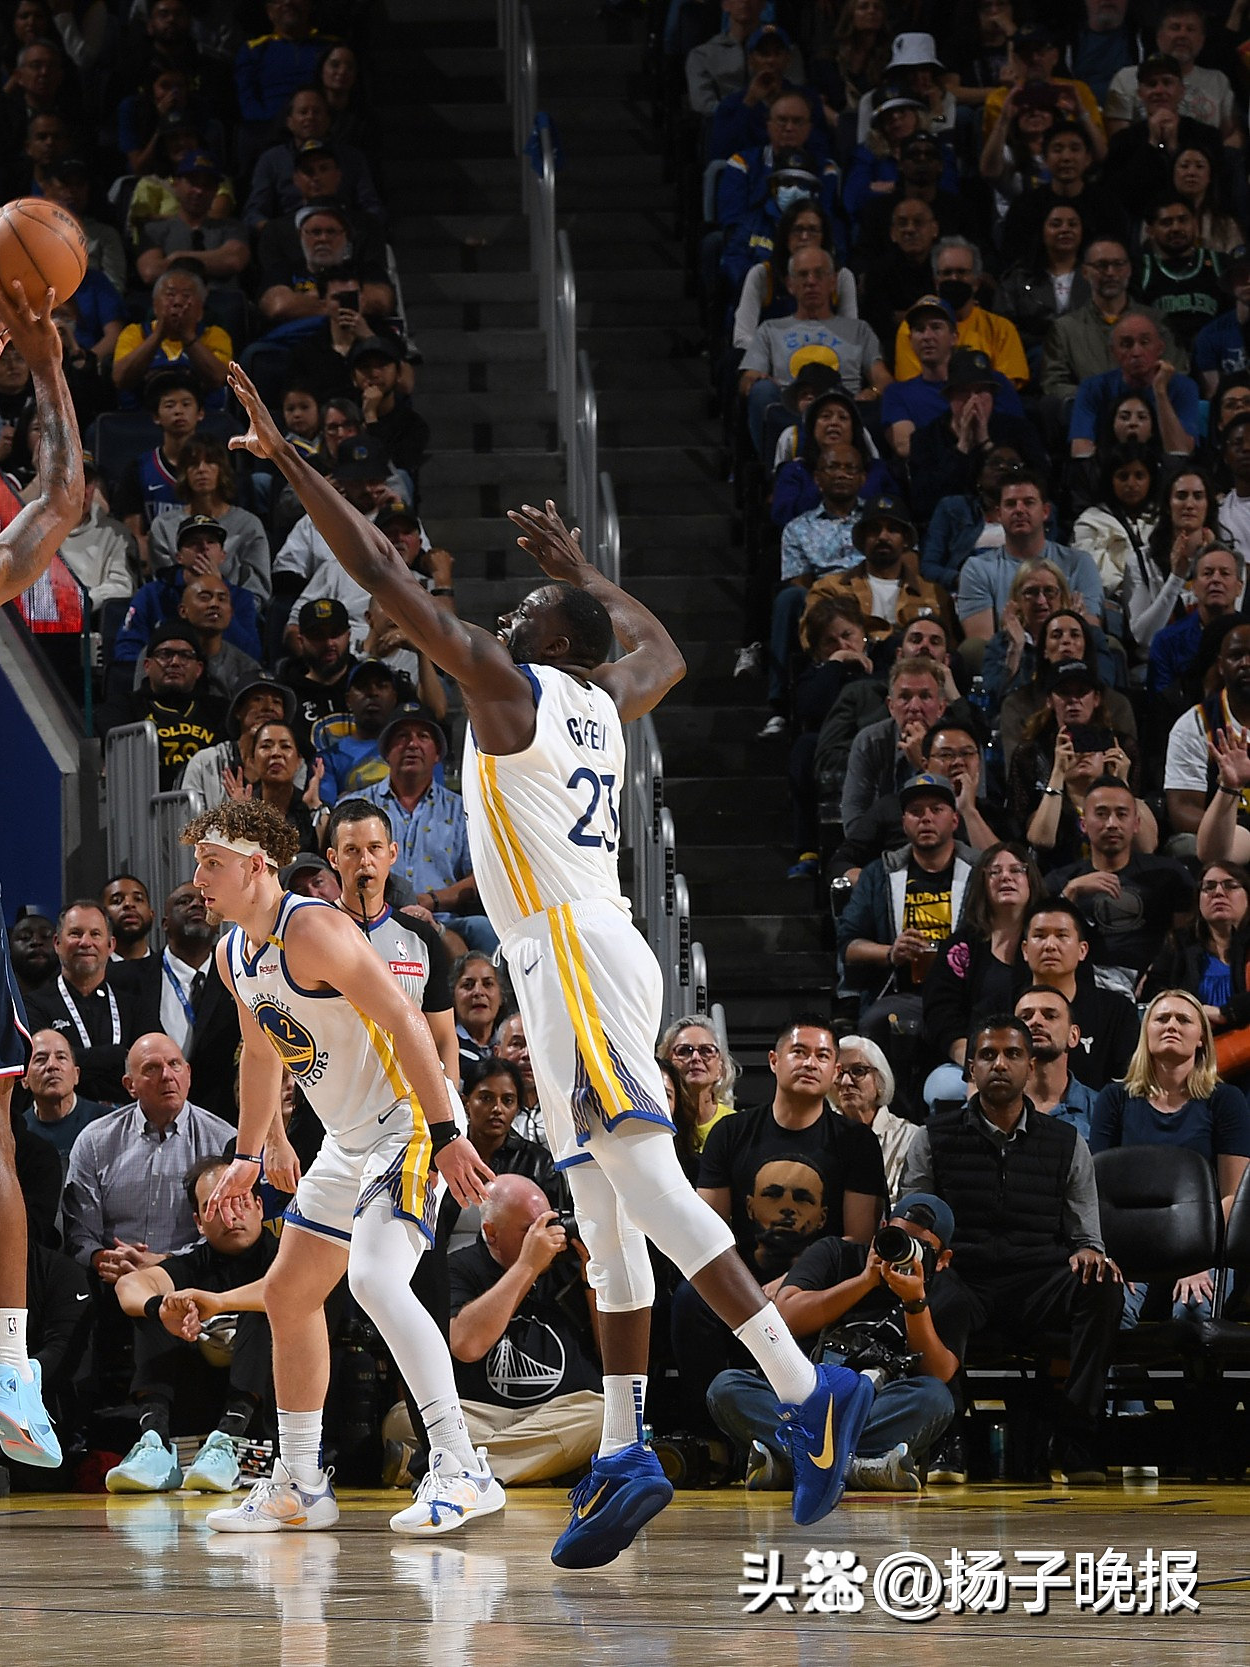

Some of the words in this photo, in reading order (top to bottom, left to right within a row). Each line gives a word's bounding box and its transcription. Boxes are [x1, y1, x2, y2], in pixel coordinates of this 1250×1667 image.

[157, 722, 215, 745] OLDEN
[390, 963, 424, 975] Emirates
[266, 993, 292, 1014] STATE
[279, 1018, 296, 1039] 2
